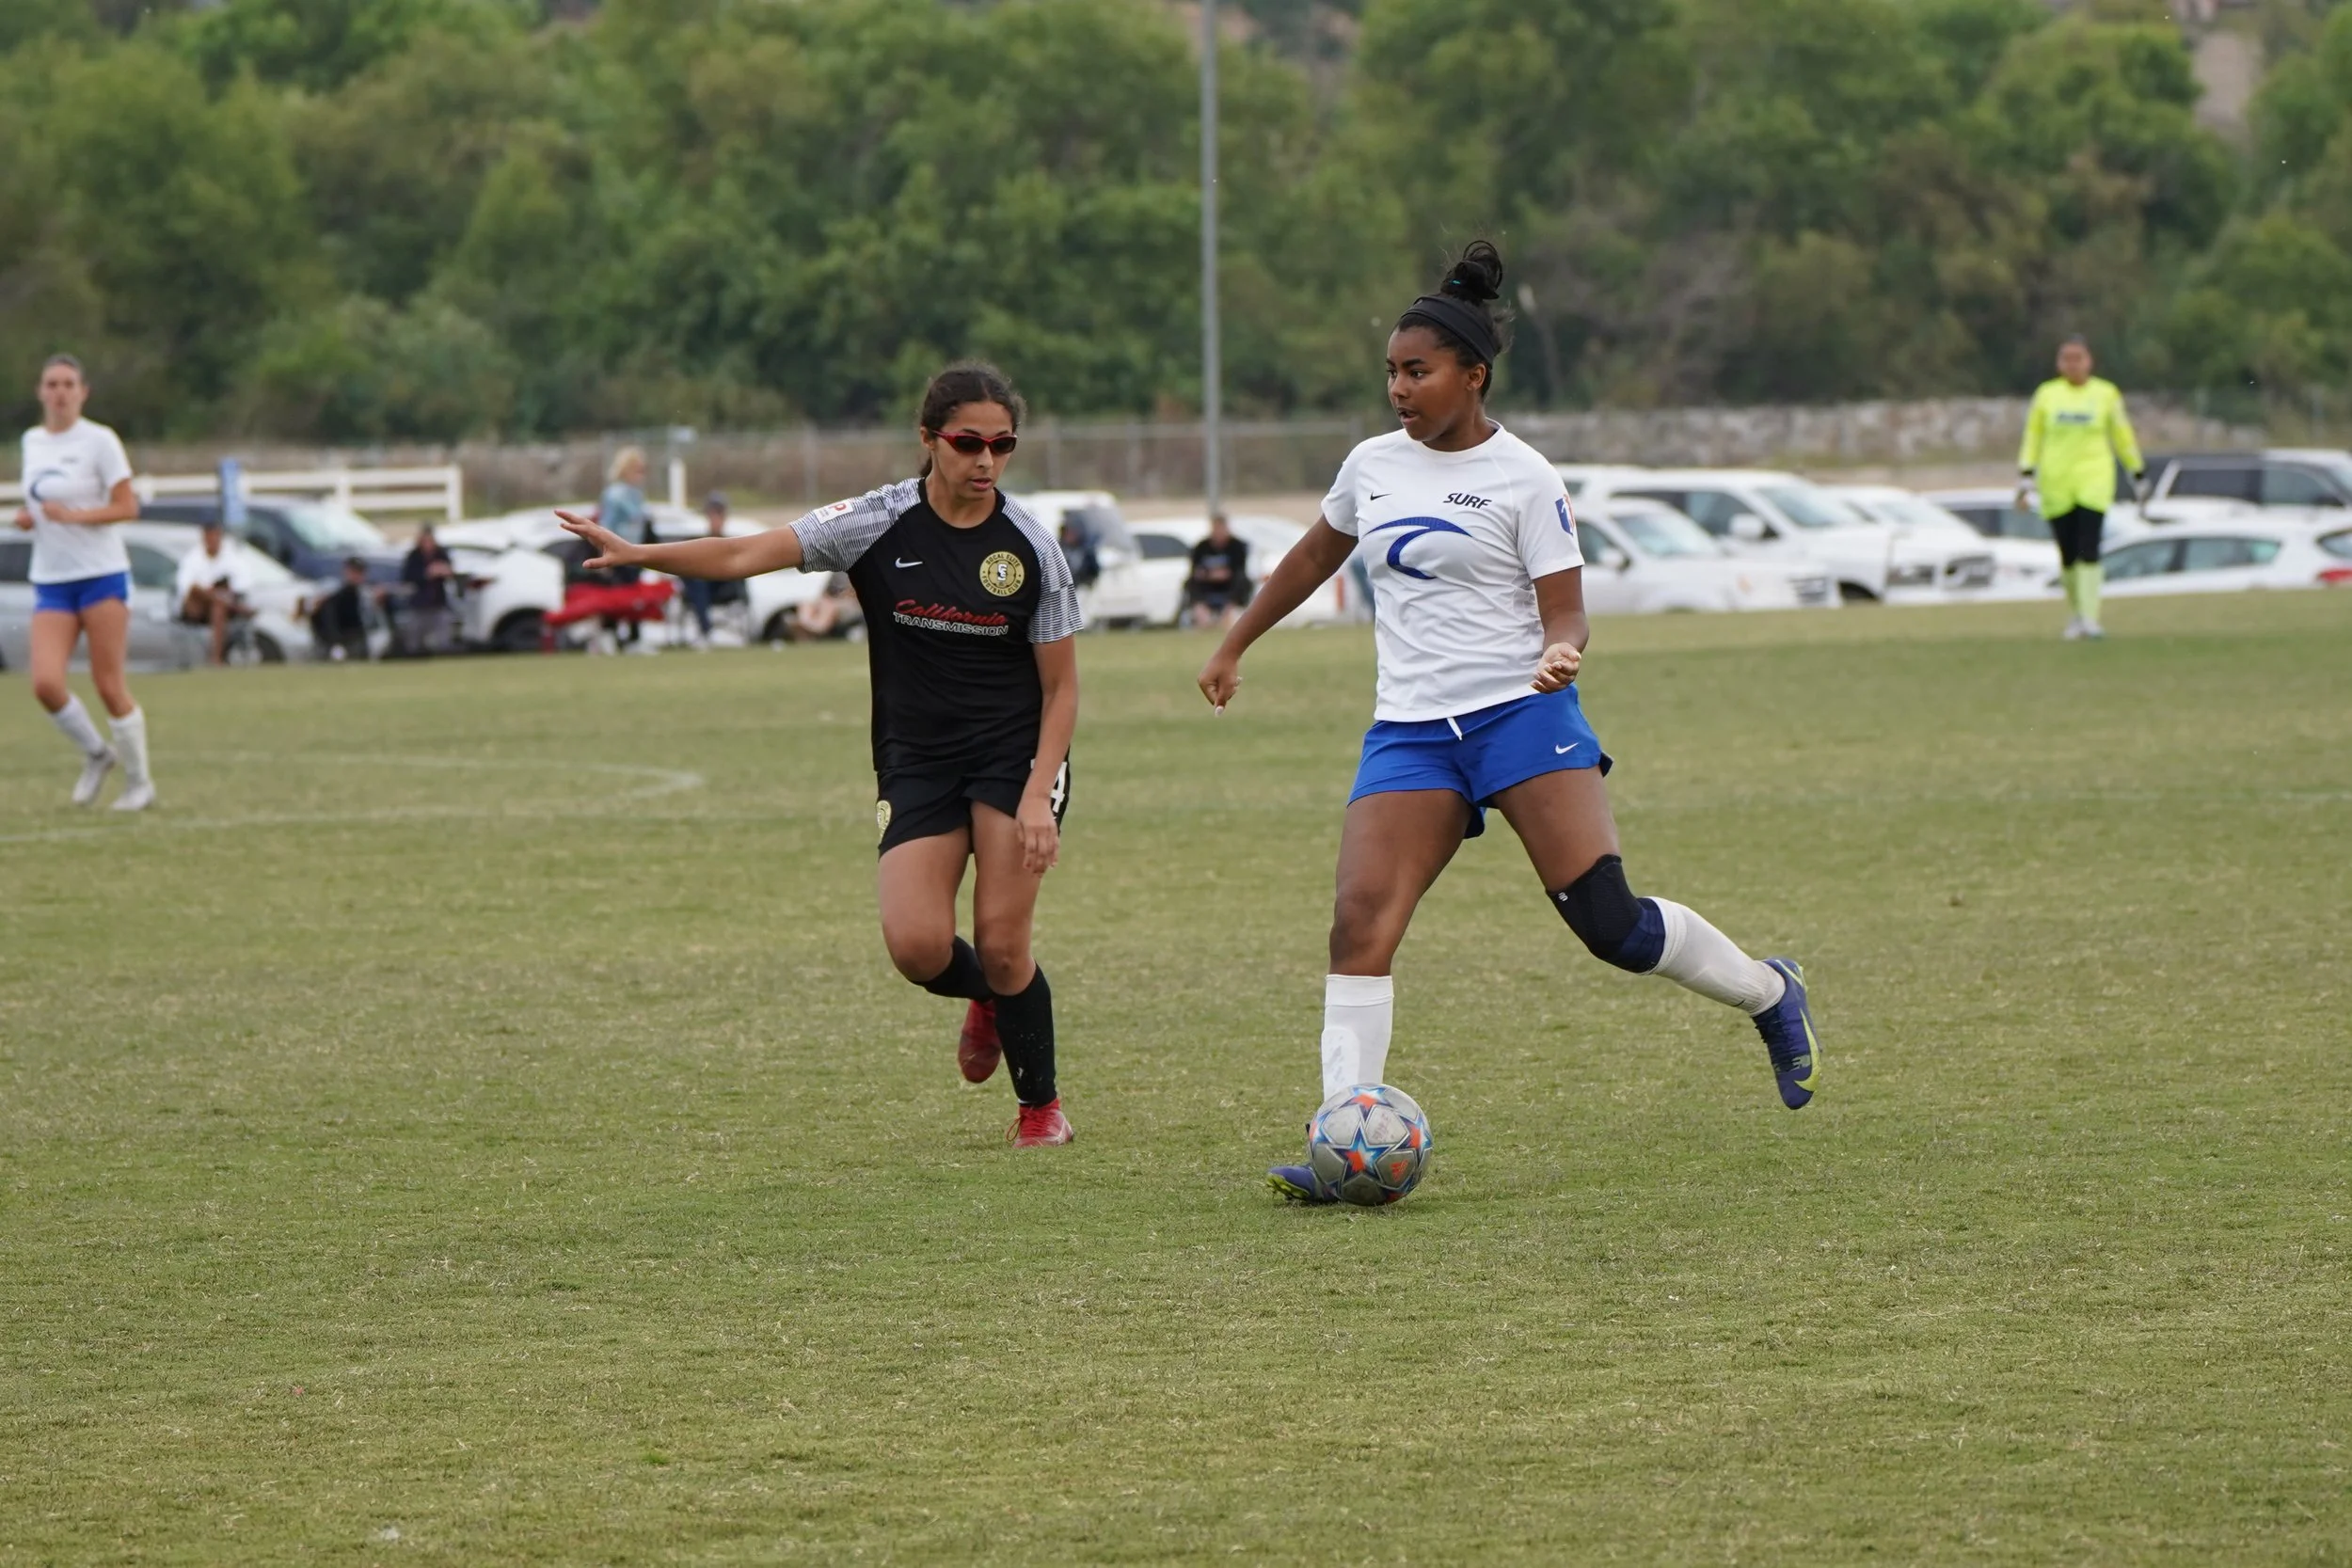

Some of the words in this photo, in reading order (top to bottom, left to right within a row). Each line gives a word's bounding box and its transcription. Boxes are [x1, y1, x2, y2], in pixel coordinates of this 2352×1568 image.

[1442, 493, 1492, 509] SURF
[981, 575, 1008, 595] FOOTBALL
[1007, 579, 1022, 594] CLUB
[893, 611, 1009, 636] TRANSMISSION
